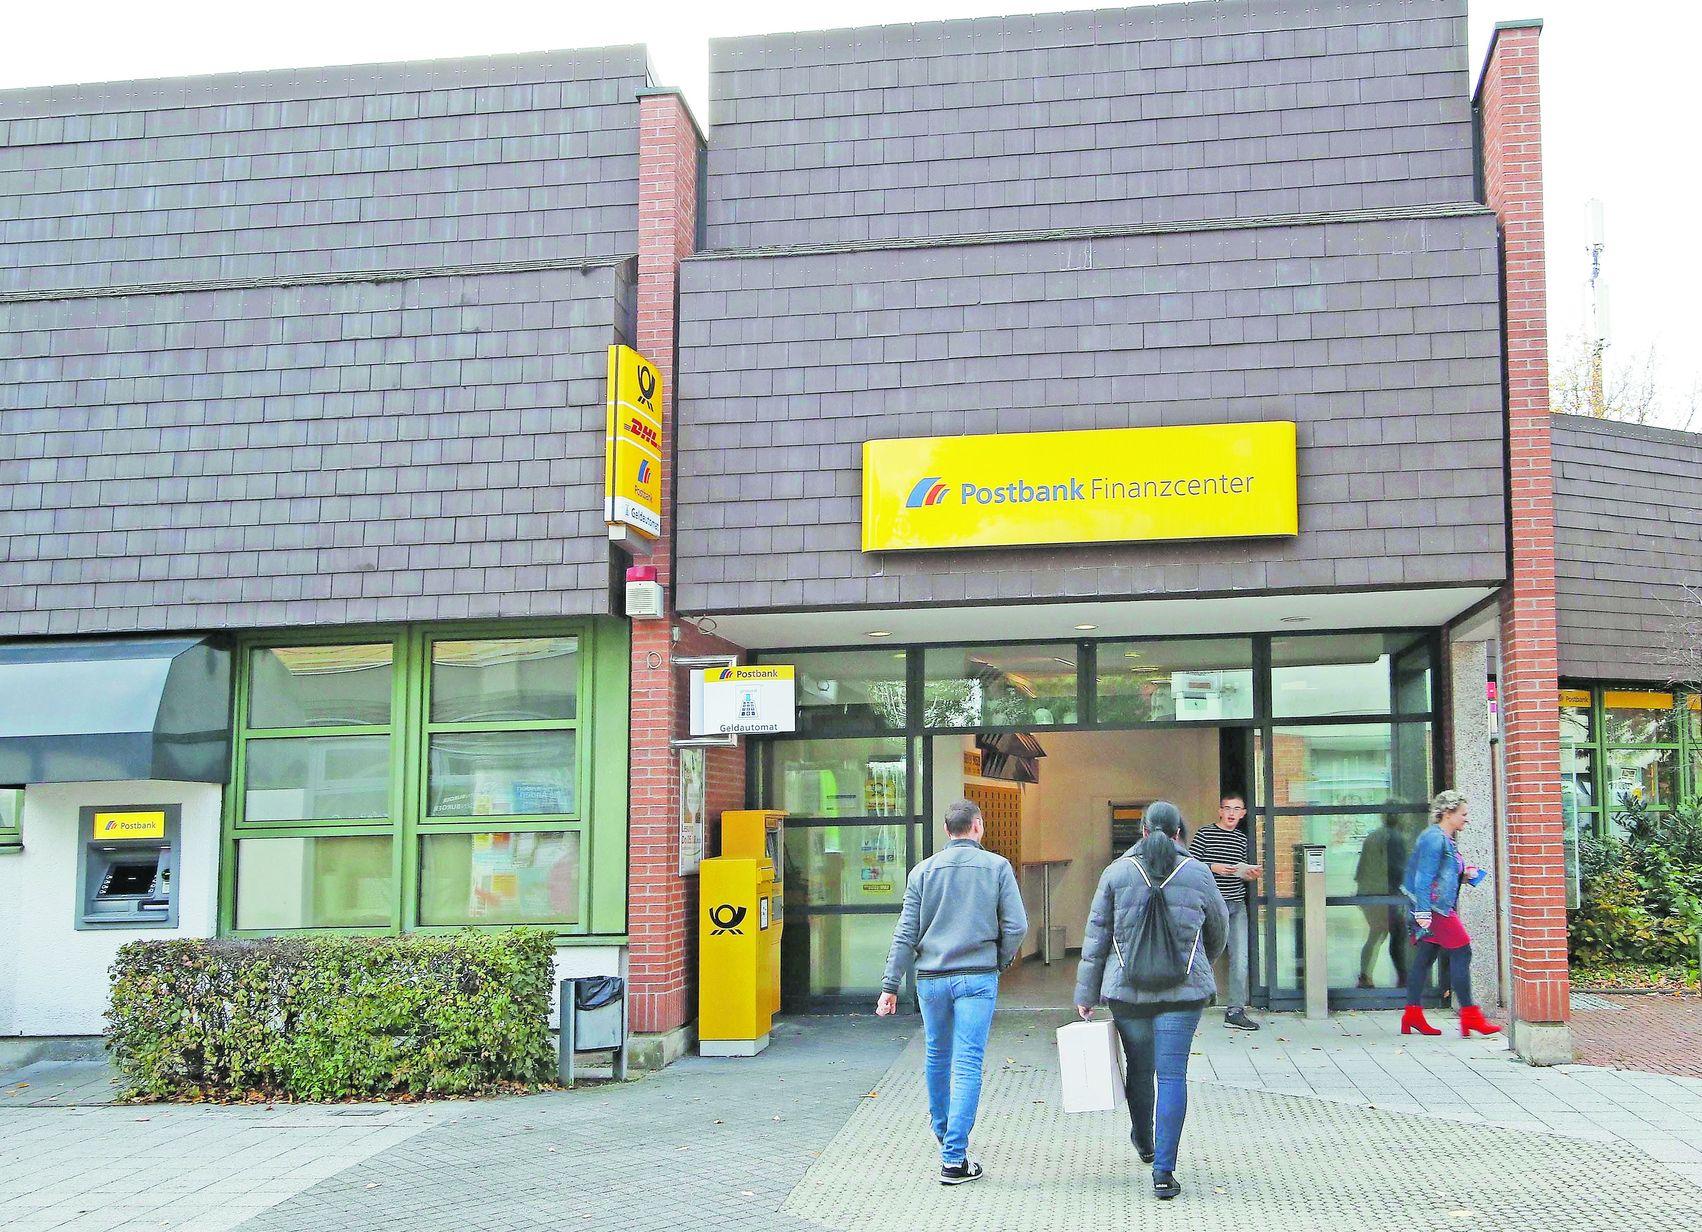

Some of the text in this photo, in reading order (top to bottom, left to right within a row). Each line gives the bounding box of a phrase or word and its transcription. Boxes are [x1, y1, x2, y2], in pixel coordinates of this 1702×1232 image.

[631, 418, 658, 448] DHL
[635, 485, 653, 503] Postbank
[961, 474, 1255, 504] Postbank Finanzcenter
[631, 507, 660, 532] Geldautomat
[736, 669, 778, 678] Postbank
[719, 724, 778, 733] Geldautomat
[120, 821, 156, 830] Postbank
